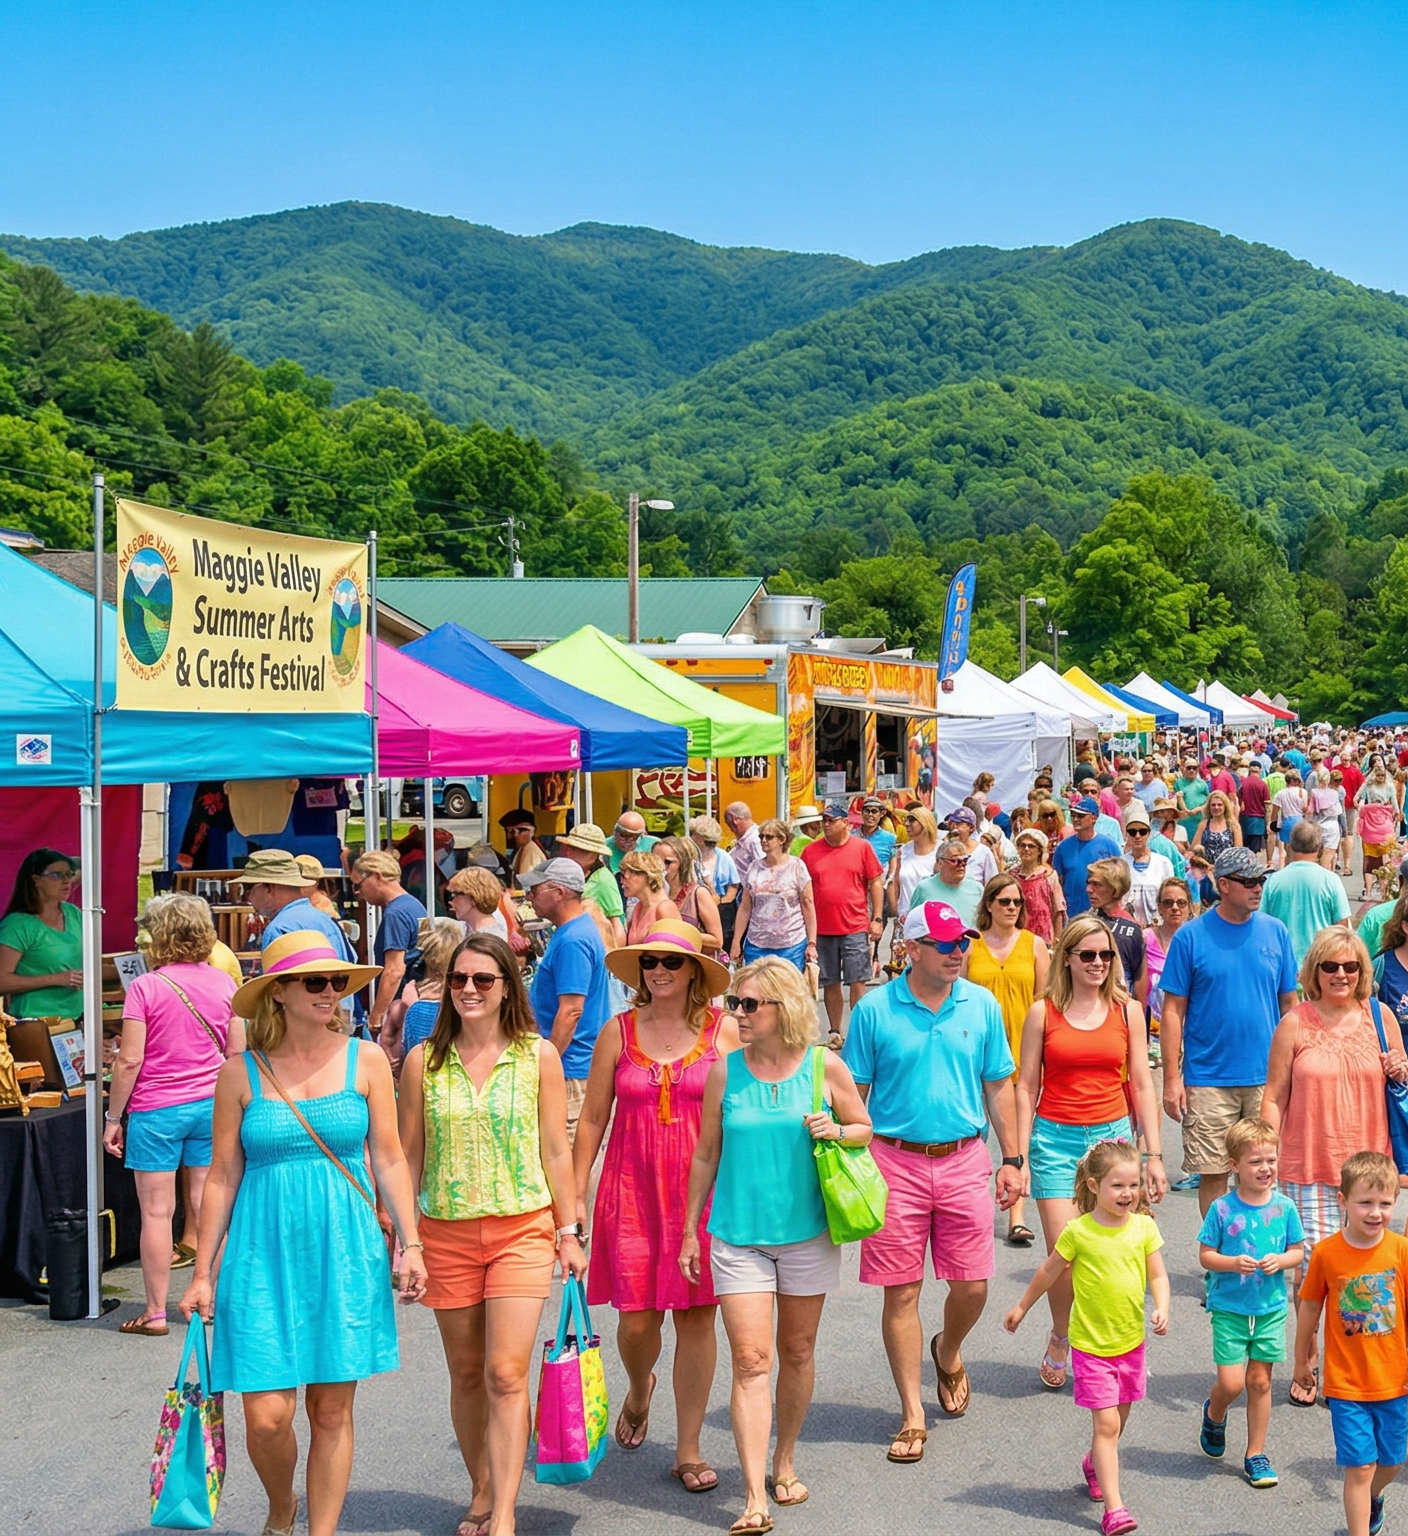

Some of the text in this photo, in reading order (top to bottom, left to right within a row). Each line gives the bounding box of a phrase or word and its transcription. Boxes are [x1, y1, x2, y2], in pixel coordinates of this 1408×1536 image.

[192, 538, 265, 594] Maggie
[267, 551, 321, 603] Valley
[193, 594, 314, 643] Summer Arts
[175, 646, 191, 687] &
[196, 648, 255, 690] Crafts
[260, 653, 325, 692] Festival
